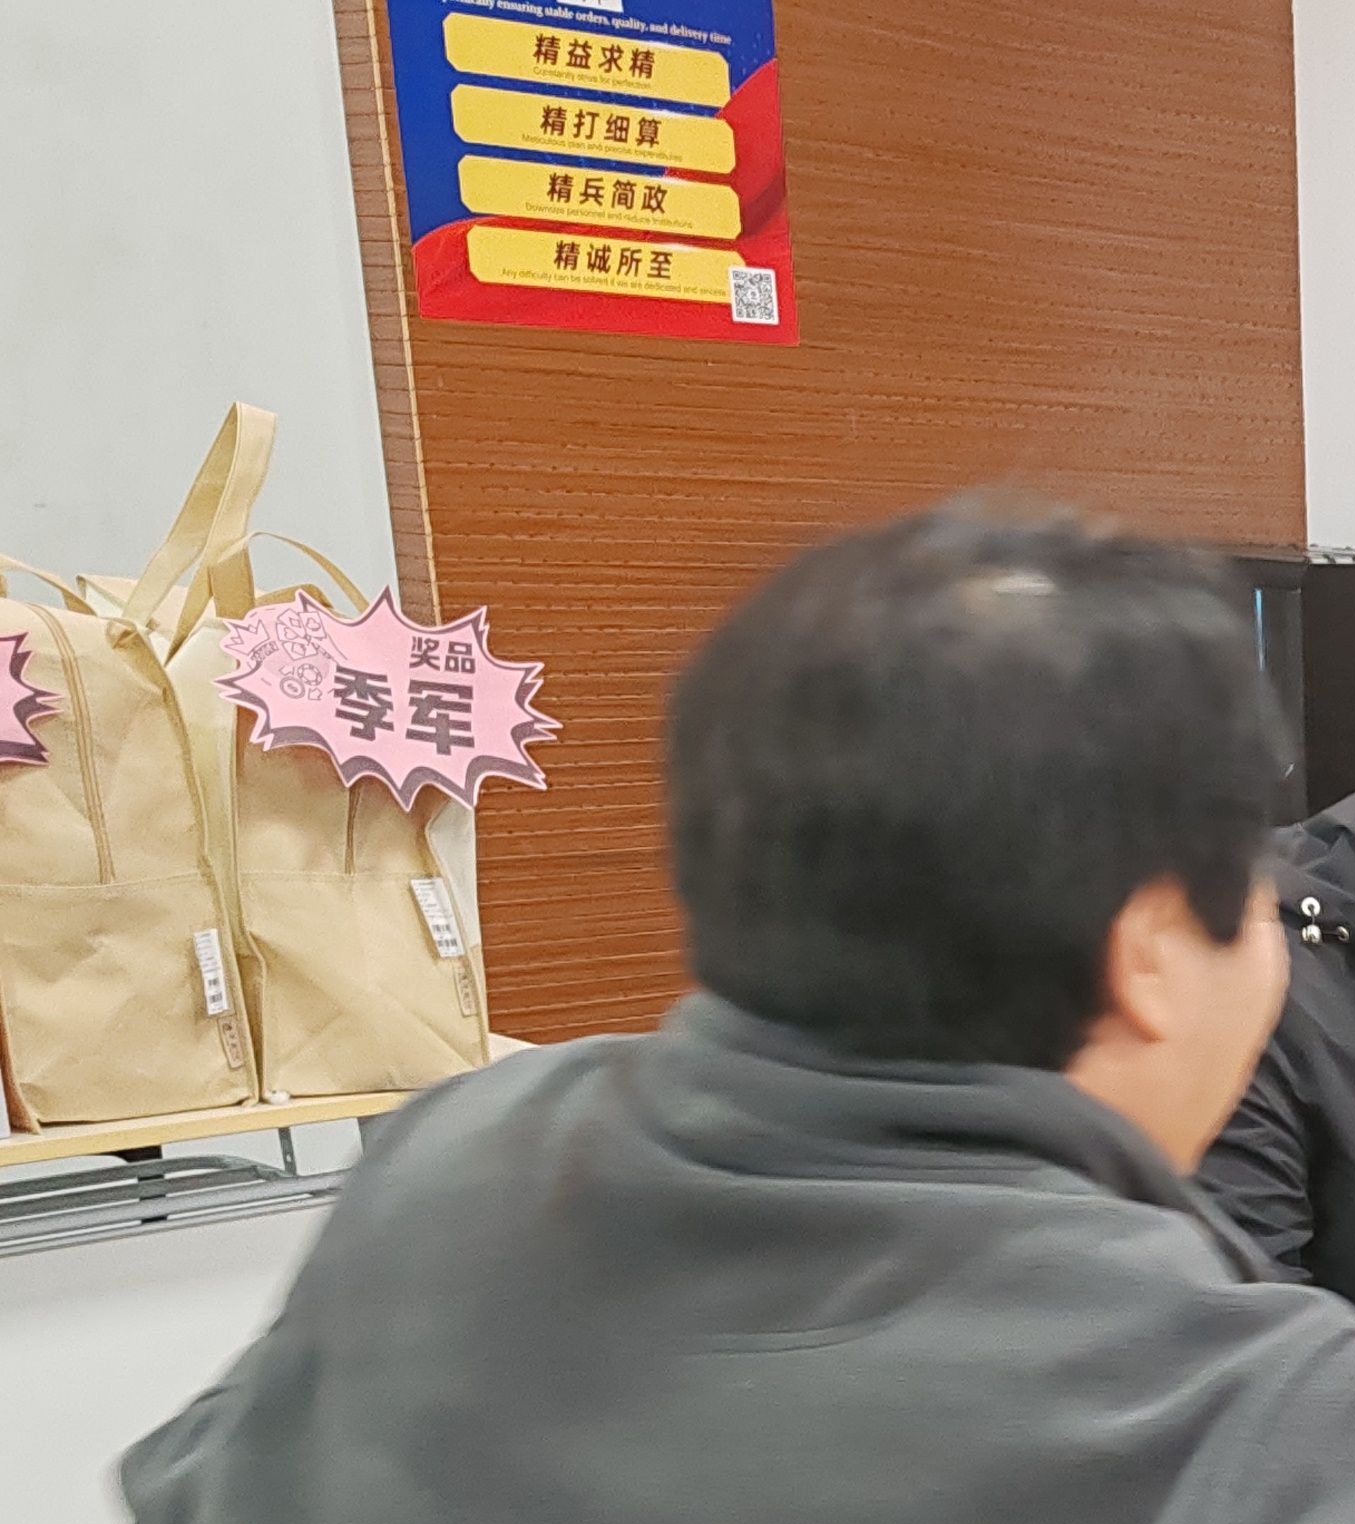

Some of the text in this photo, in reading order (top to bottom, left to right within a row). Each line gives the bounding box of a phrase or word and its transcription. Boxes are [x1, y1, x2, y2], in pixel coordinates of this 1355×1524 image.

[496, 2, 543, 17] ensuring
[545, 6, 574, 20] stable
[650, 23, 668, 35] and
[670, 25, 708, 43] delivery
[533, 33, 655, 79] 精益求精
[540, 105, 662, 148] 精打细算
[546, 172, 668, 214] 精兵简政
[554, 240, 673, 280] 精诚所至
[409, 636, 476, 674] 奖品
[334, 665, 475, 756] 季军
